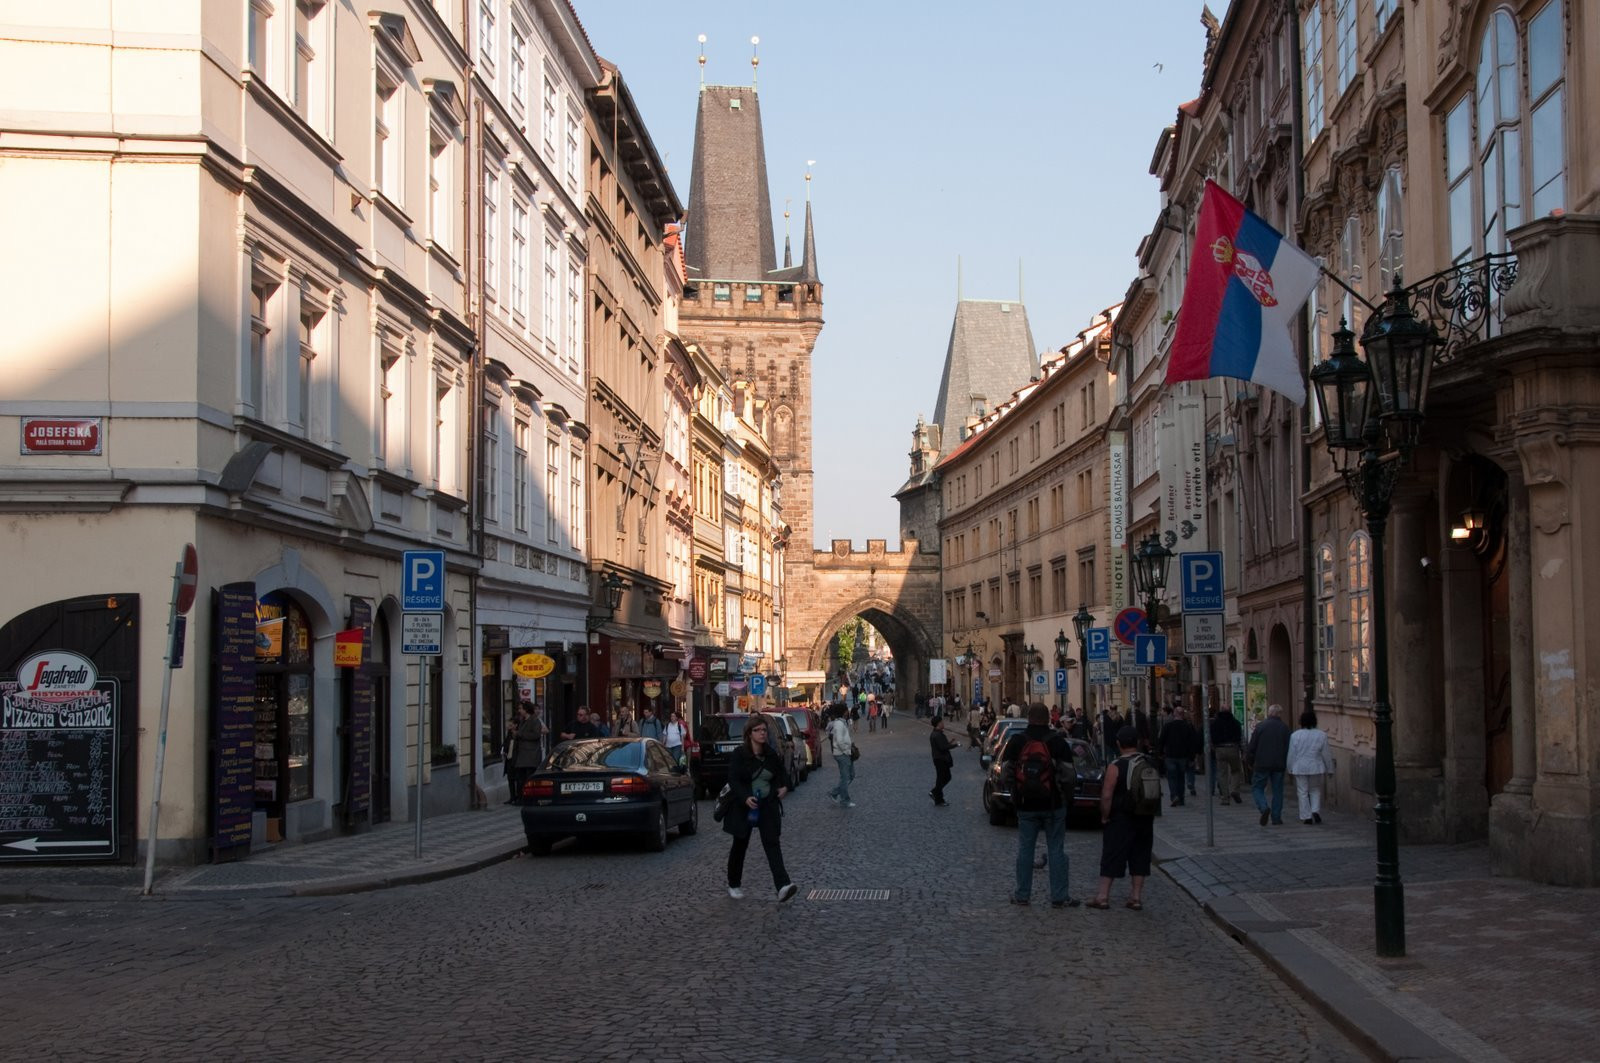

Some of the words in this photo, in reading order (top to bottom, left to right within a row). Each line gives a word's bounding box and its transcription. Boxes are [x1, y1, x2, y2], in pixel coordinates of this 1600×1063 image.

[30, 425, 92, 437] JOSEFSKÁ
[35, 438, 47, 446] MALÁ
[1192, 442, 1201, 462] orla
[1113, 452, 1122, 502] BALTHASAR
[1114, 504, 1123, 540] DOMUS
[411, 558, 436, 592] P
[1114, 553, 1123, 590] HOTEL
[1190, 560, 1214, 593] P
[1091, 632, 1105, 651] P
[27, 661, 88, 690] Segafredo
[753, 677, 762, 689] P
[1057, 672, 1065, 687] P
[3, 696, 55, 728] Pizzeria
[59, 703, 112, 728] Canzone
